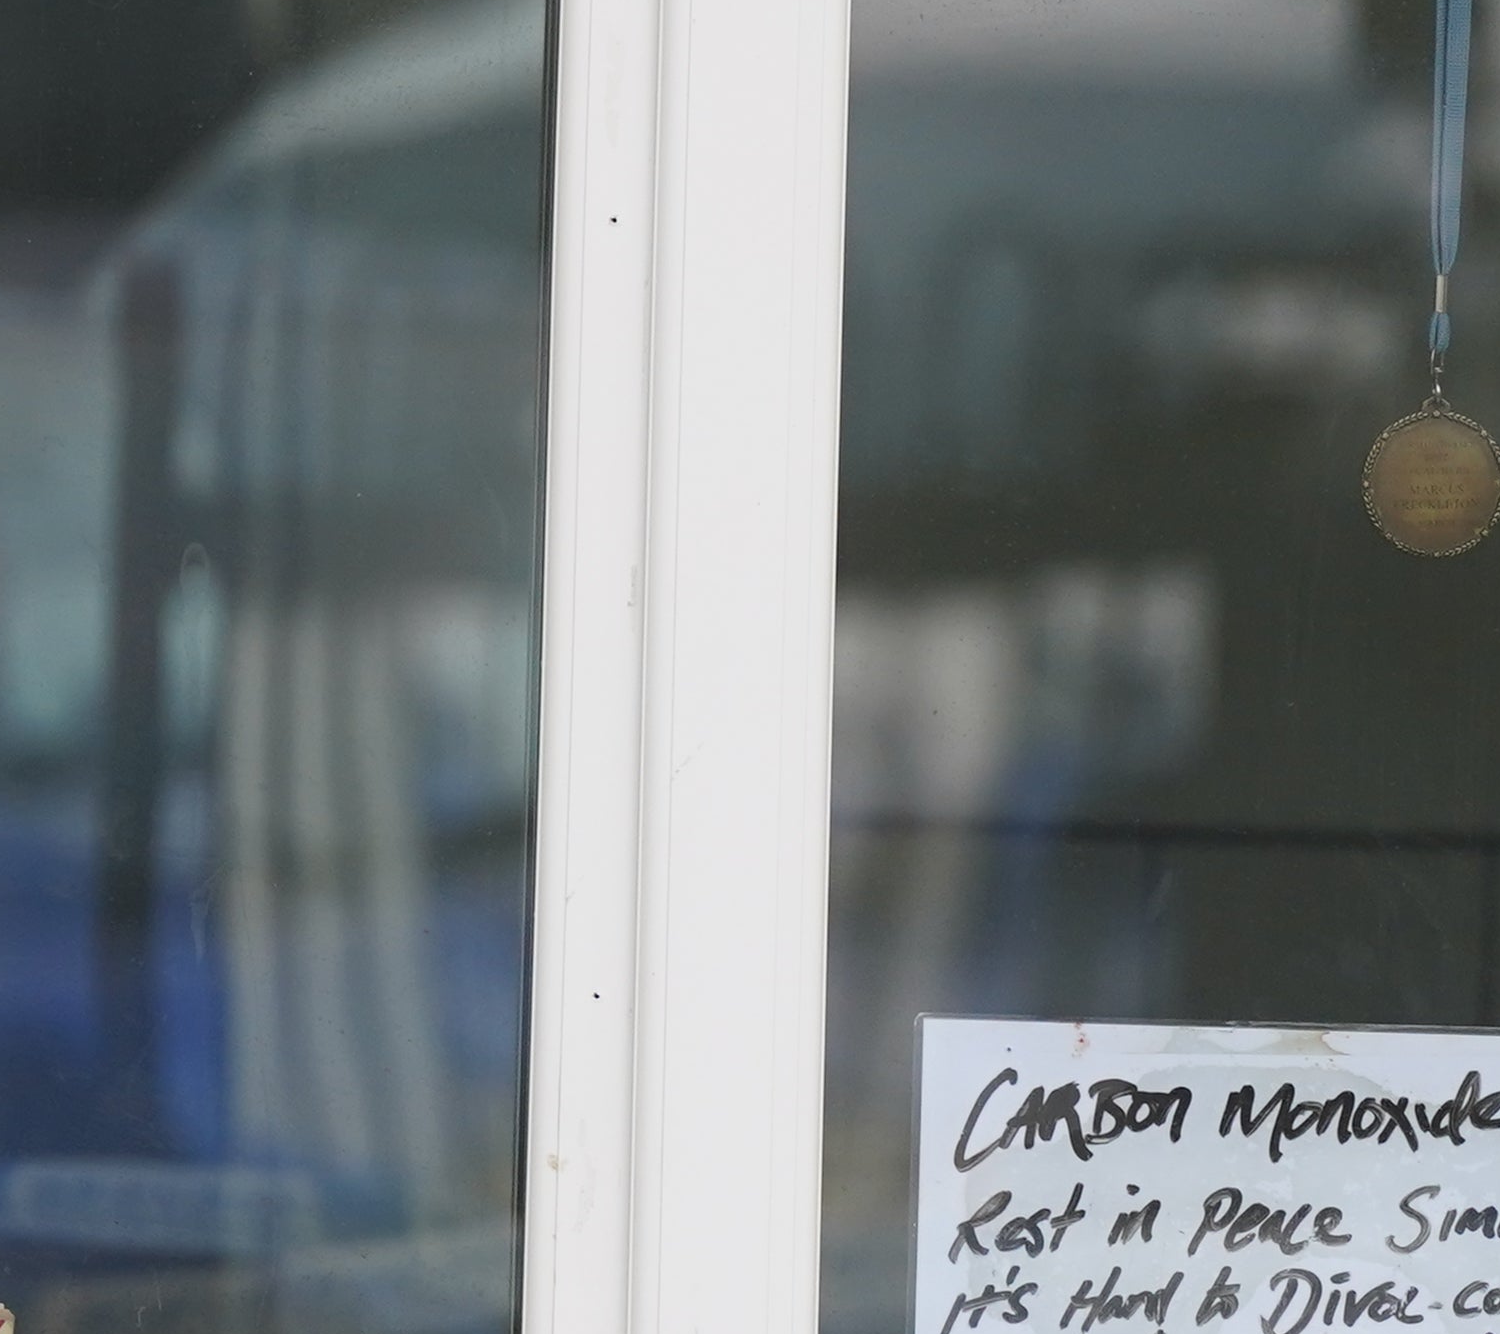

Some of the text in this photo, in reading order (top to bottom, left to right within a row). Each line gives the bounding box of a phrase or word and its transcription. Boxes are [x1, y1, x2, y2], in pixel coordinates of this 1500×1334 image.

[949, 1183, 1086, 1263] Rest
[1107, 1183, 1162, 1247] in
[1188, 1187, 1352, 1257] Peace
[1059, 1266, 1184, 1332] Hard
[1196, 1266, 1240, 1326] to
